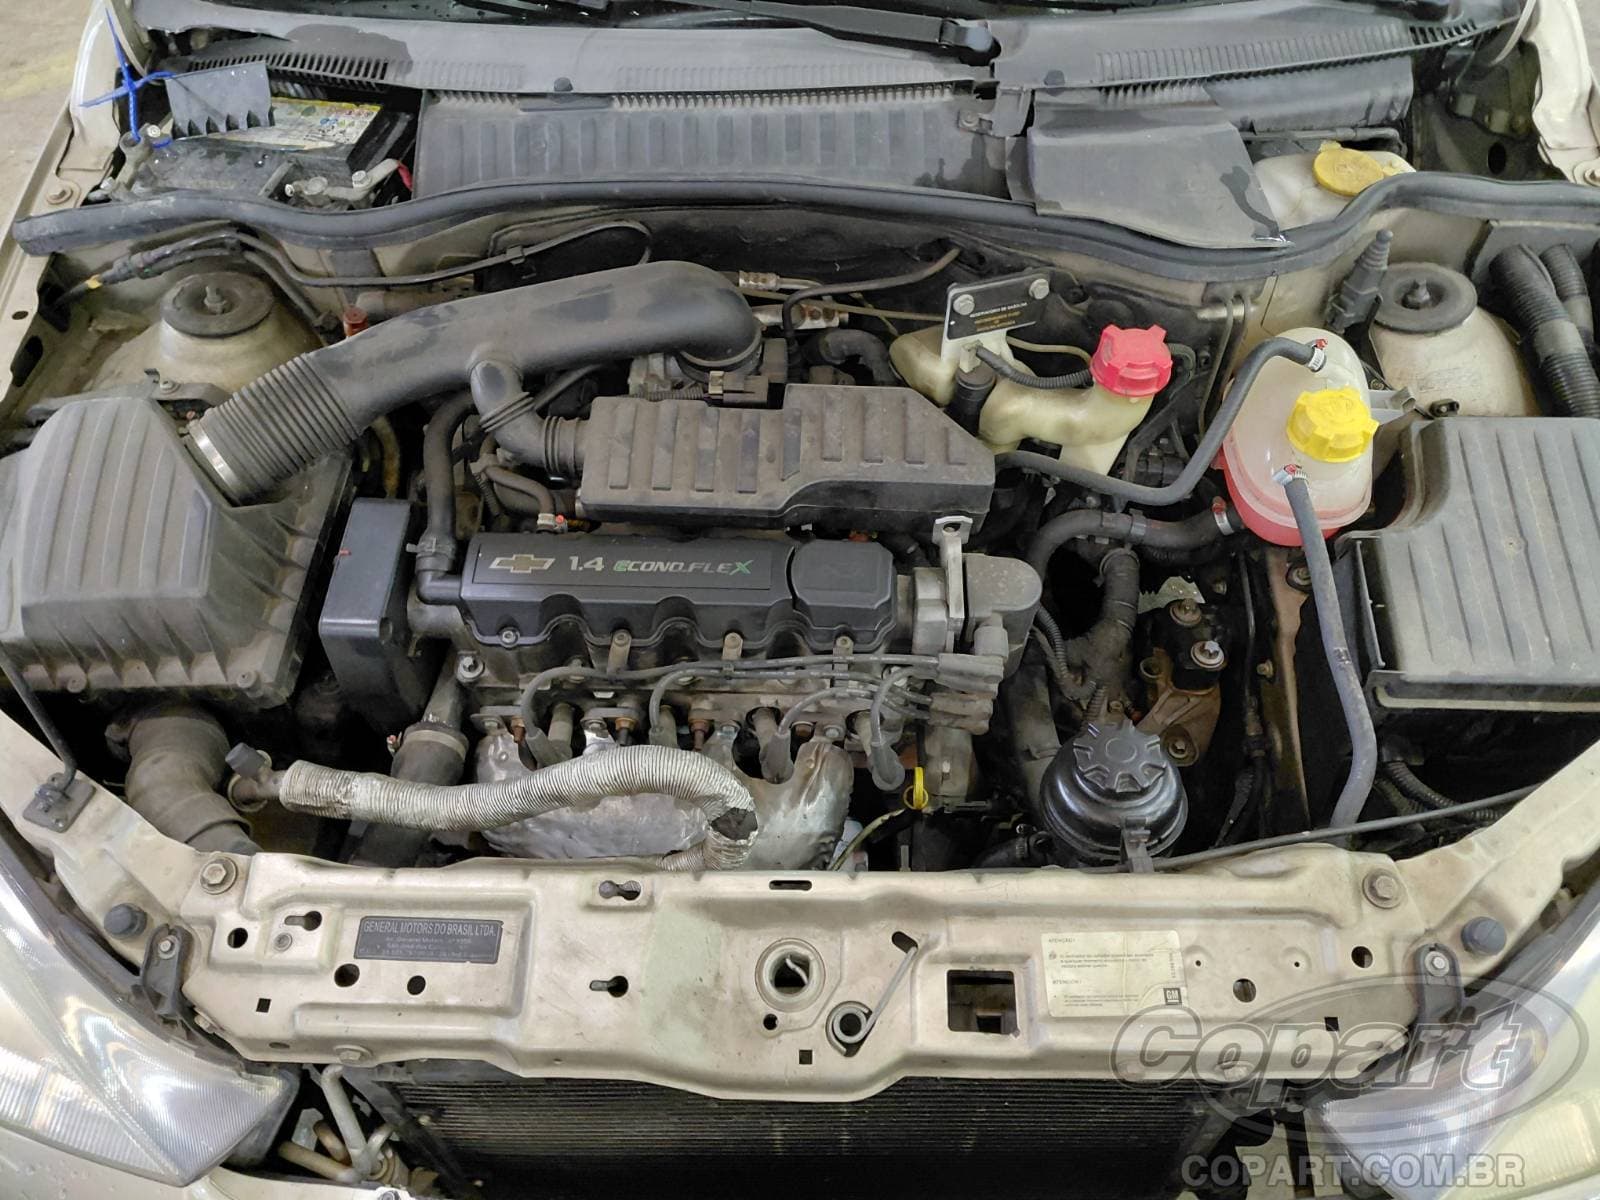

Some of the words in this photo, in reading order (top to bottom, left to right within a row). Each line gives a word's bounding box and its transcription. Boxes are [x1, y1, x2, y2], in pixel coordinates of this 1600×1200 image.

[568, 556, 605, 572] 1.4
[363, 920, 398, 934] GENERAL
[400, 922, 433, 935] MOTORS
[433, 923, 446, 935] DO
[446, 923, 474, 936] BRASIL
[475, 924, 497, 937] LTDA.
